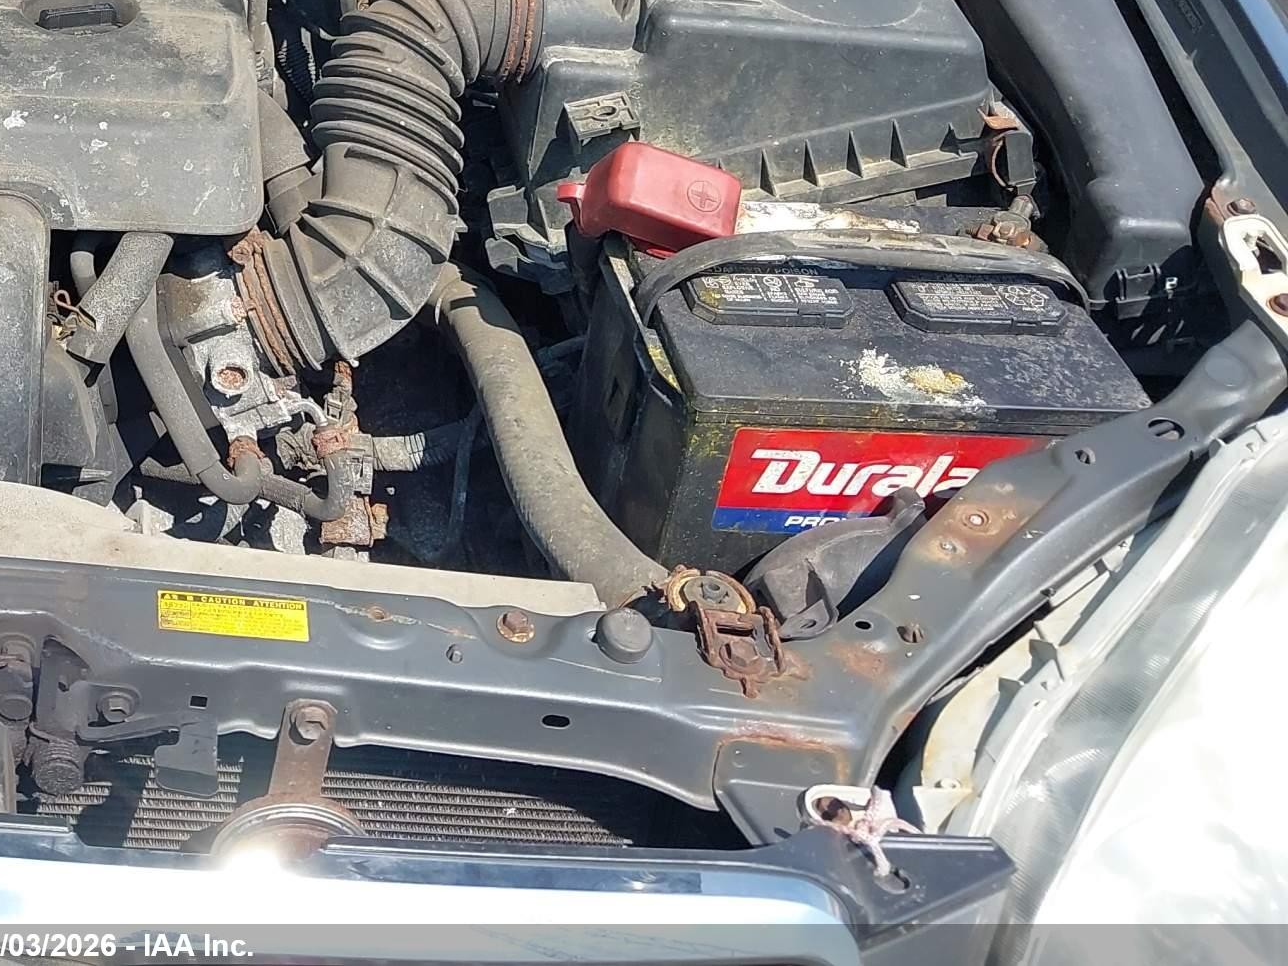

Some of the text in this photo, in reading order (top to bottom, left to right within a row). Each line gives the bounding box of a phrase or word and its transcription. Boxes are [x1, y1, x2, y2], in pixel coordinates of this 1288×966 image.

[775, 267, 818, 276] POISON
[201, 597, 246, 606] CAUTION
[253, 599, 303, 610] ATTENTION
